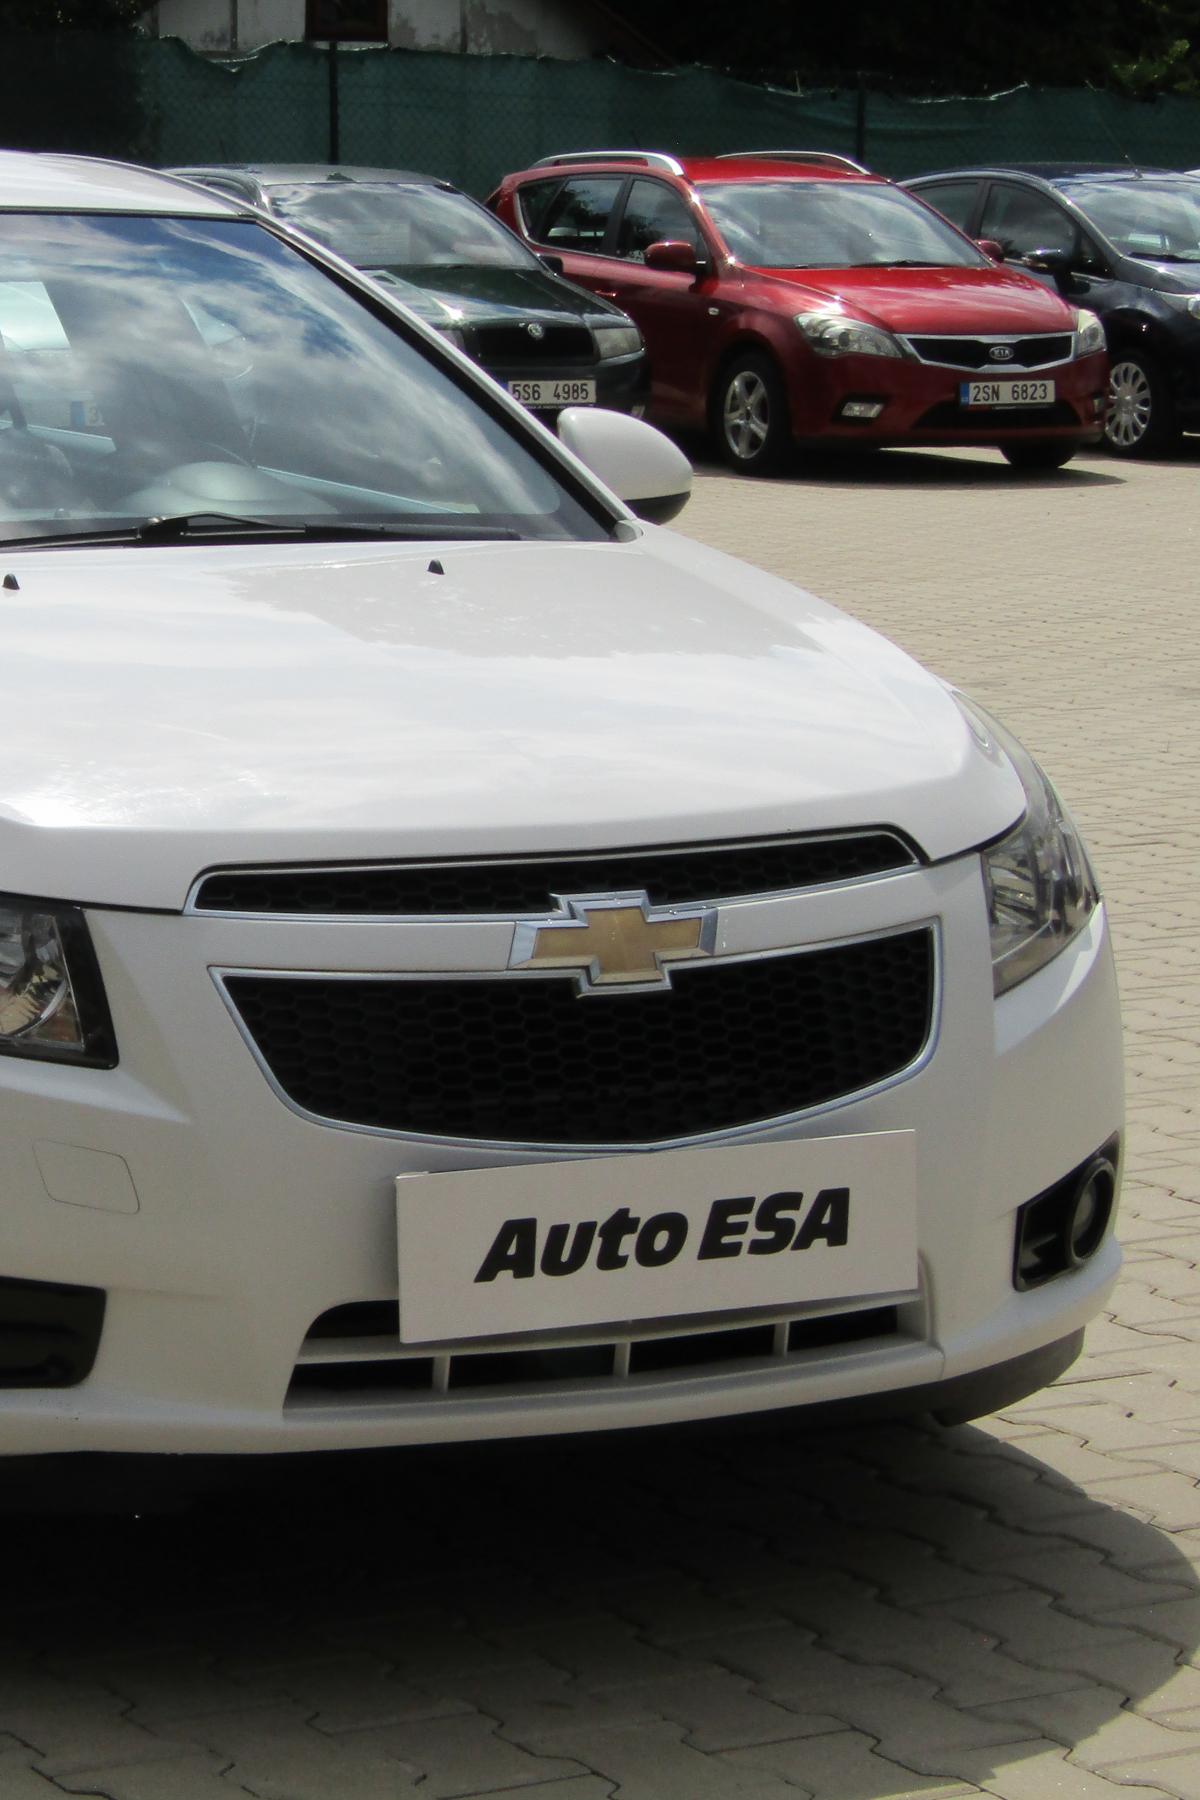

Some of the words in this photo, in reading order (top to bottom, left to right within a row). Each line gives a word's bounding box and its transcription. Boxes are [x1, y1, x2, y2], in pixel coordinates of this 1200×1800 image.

[512, 383, 541, 401] 5S6
[553, 383, 589, 400] 4985
[973, 384, 1000, 402] 2SN
[1011, 383, 1048, 401] 6823
[473, 1207, 689, 1283] Auto
[697, 1187, 851, 1261] ESA
